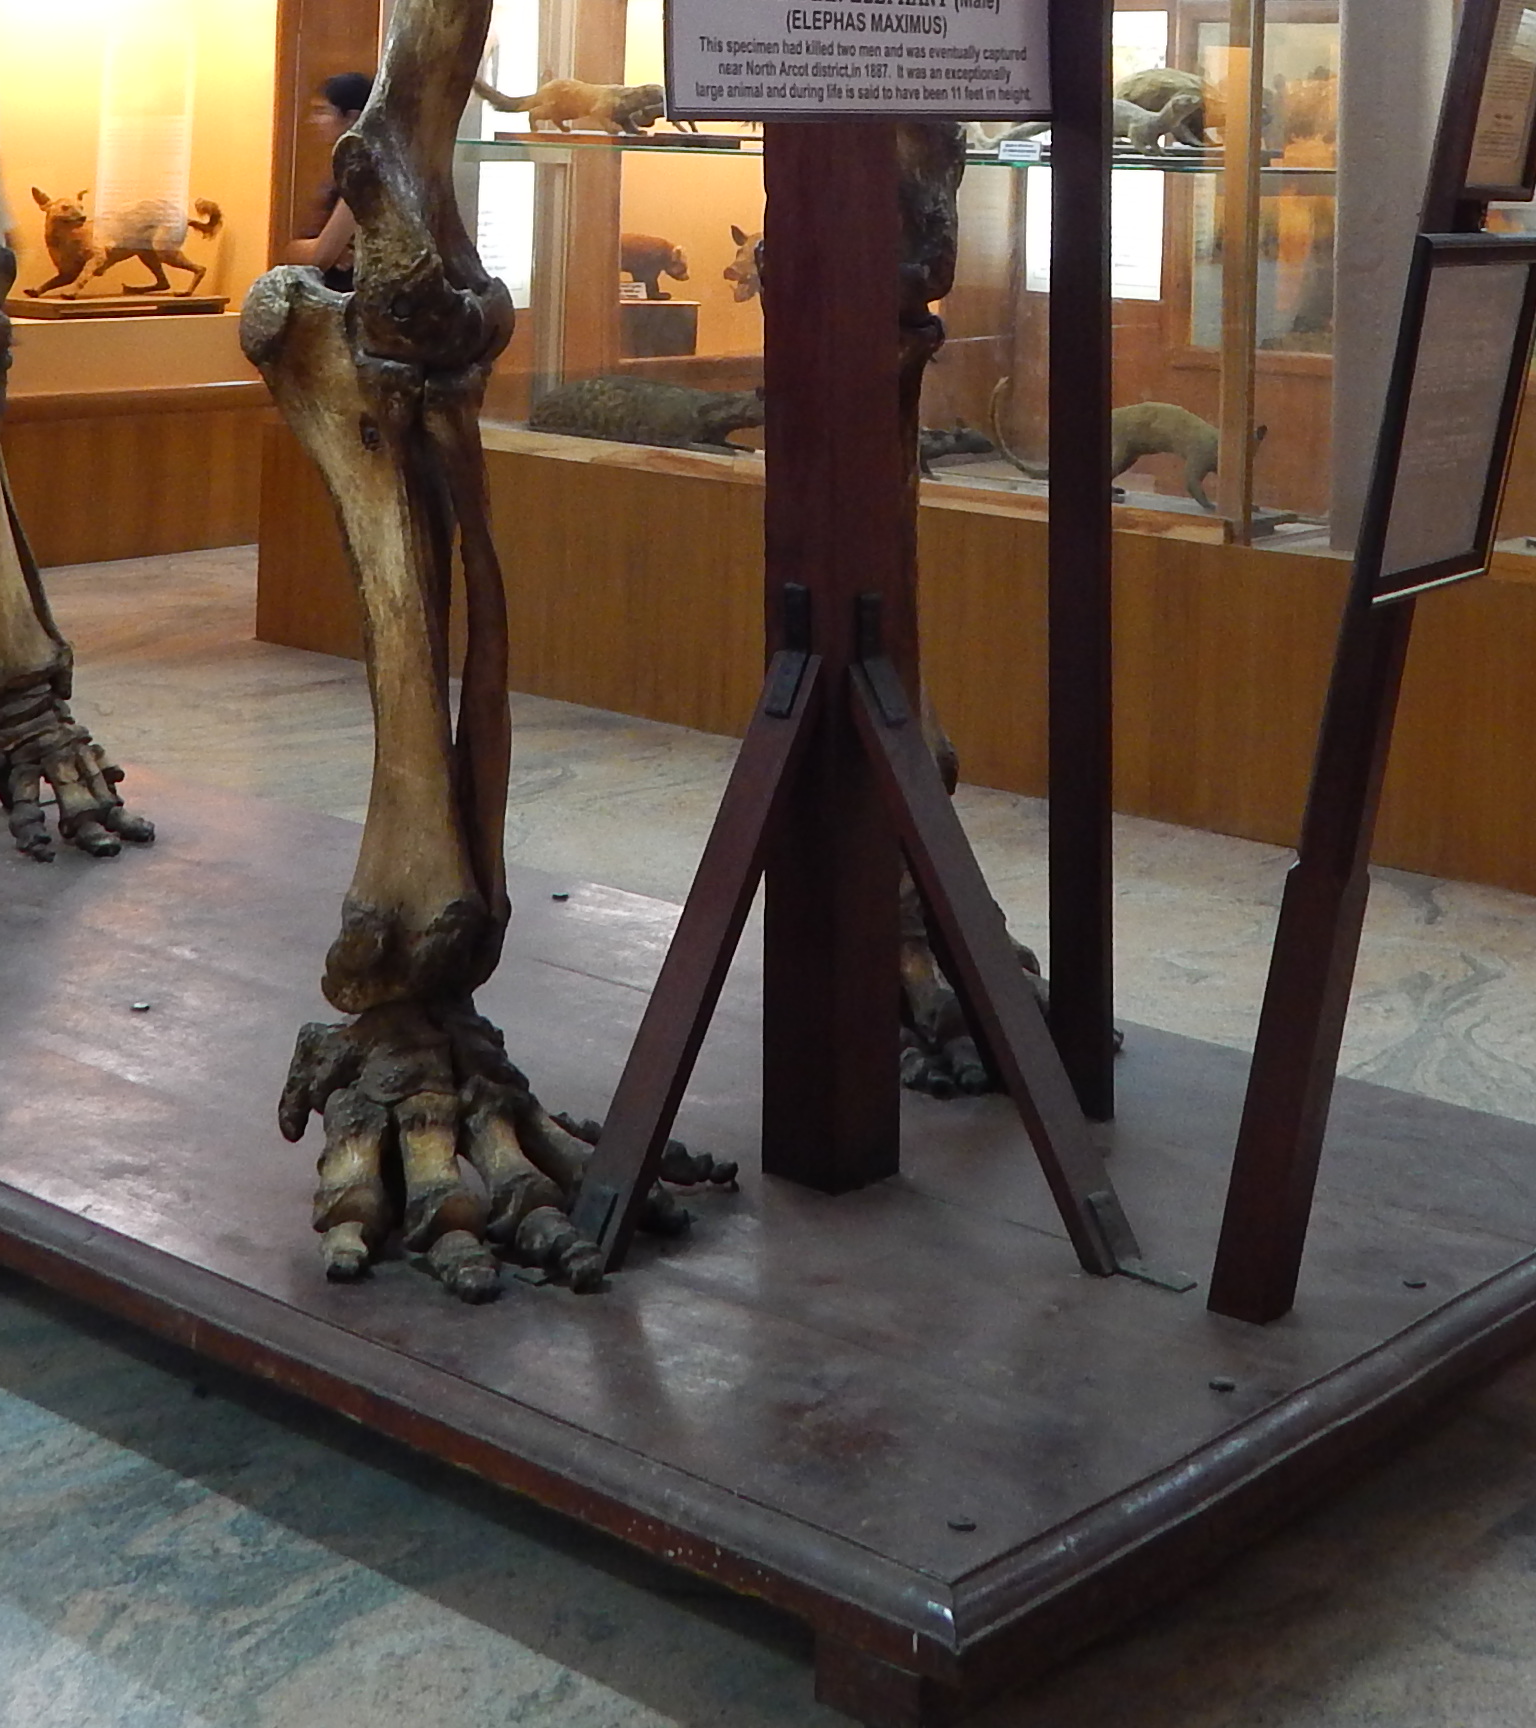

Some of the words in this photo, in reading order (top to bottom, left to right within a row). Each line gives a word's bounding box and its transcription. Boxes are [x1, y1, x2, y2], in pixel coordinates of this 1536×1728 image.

[786, 9, 866, 34] (ELEPHAS
[870, 13, 947, 39] MAXIMUS)
[699, 35, 723, 53] This
[726, 38, 779, 56] specimen
[782, 39, 802, 55] had
[805, 39, 834, 56] killed
[837, 41, 856, 56] two
[859, 45, 881, 57] men
[884, 43, 903, 58] and
[906, 46, 926, 59] was
[928, 45, 981, 63] eventually
[983, 46, 1027, 63] captured
[718, 62, 743, 76] near
[746, 60, 777, 76] North
[779, 61, 809, 77] Arcot
[896, 64, 904, 80] It
[907, 67, 927, 80] was
[929, 68, 943, 80] an
[945, 66, 1011, 84] exceptionally
[695, 81, 724, 101] large
[727, 82, 763, 98] animal
[766, 83, 786, 98] and
[789, 83, 824, 102] during
[826, 83, 843, 98] life
[845, 84, 855, 99] is
[857, 84, 879, 100] said
[882, 85, 893, 100] to
[895, 85, 920, 100] have
[922, 85, 948, 100] been
[950, 86, 961, 100] 11
[965, 86, 984, 101] feet
[986, 86, 996, 100] in
